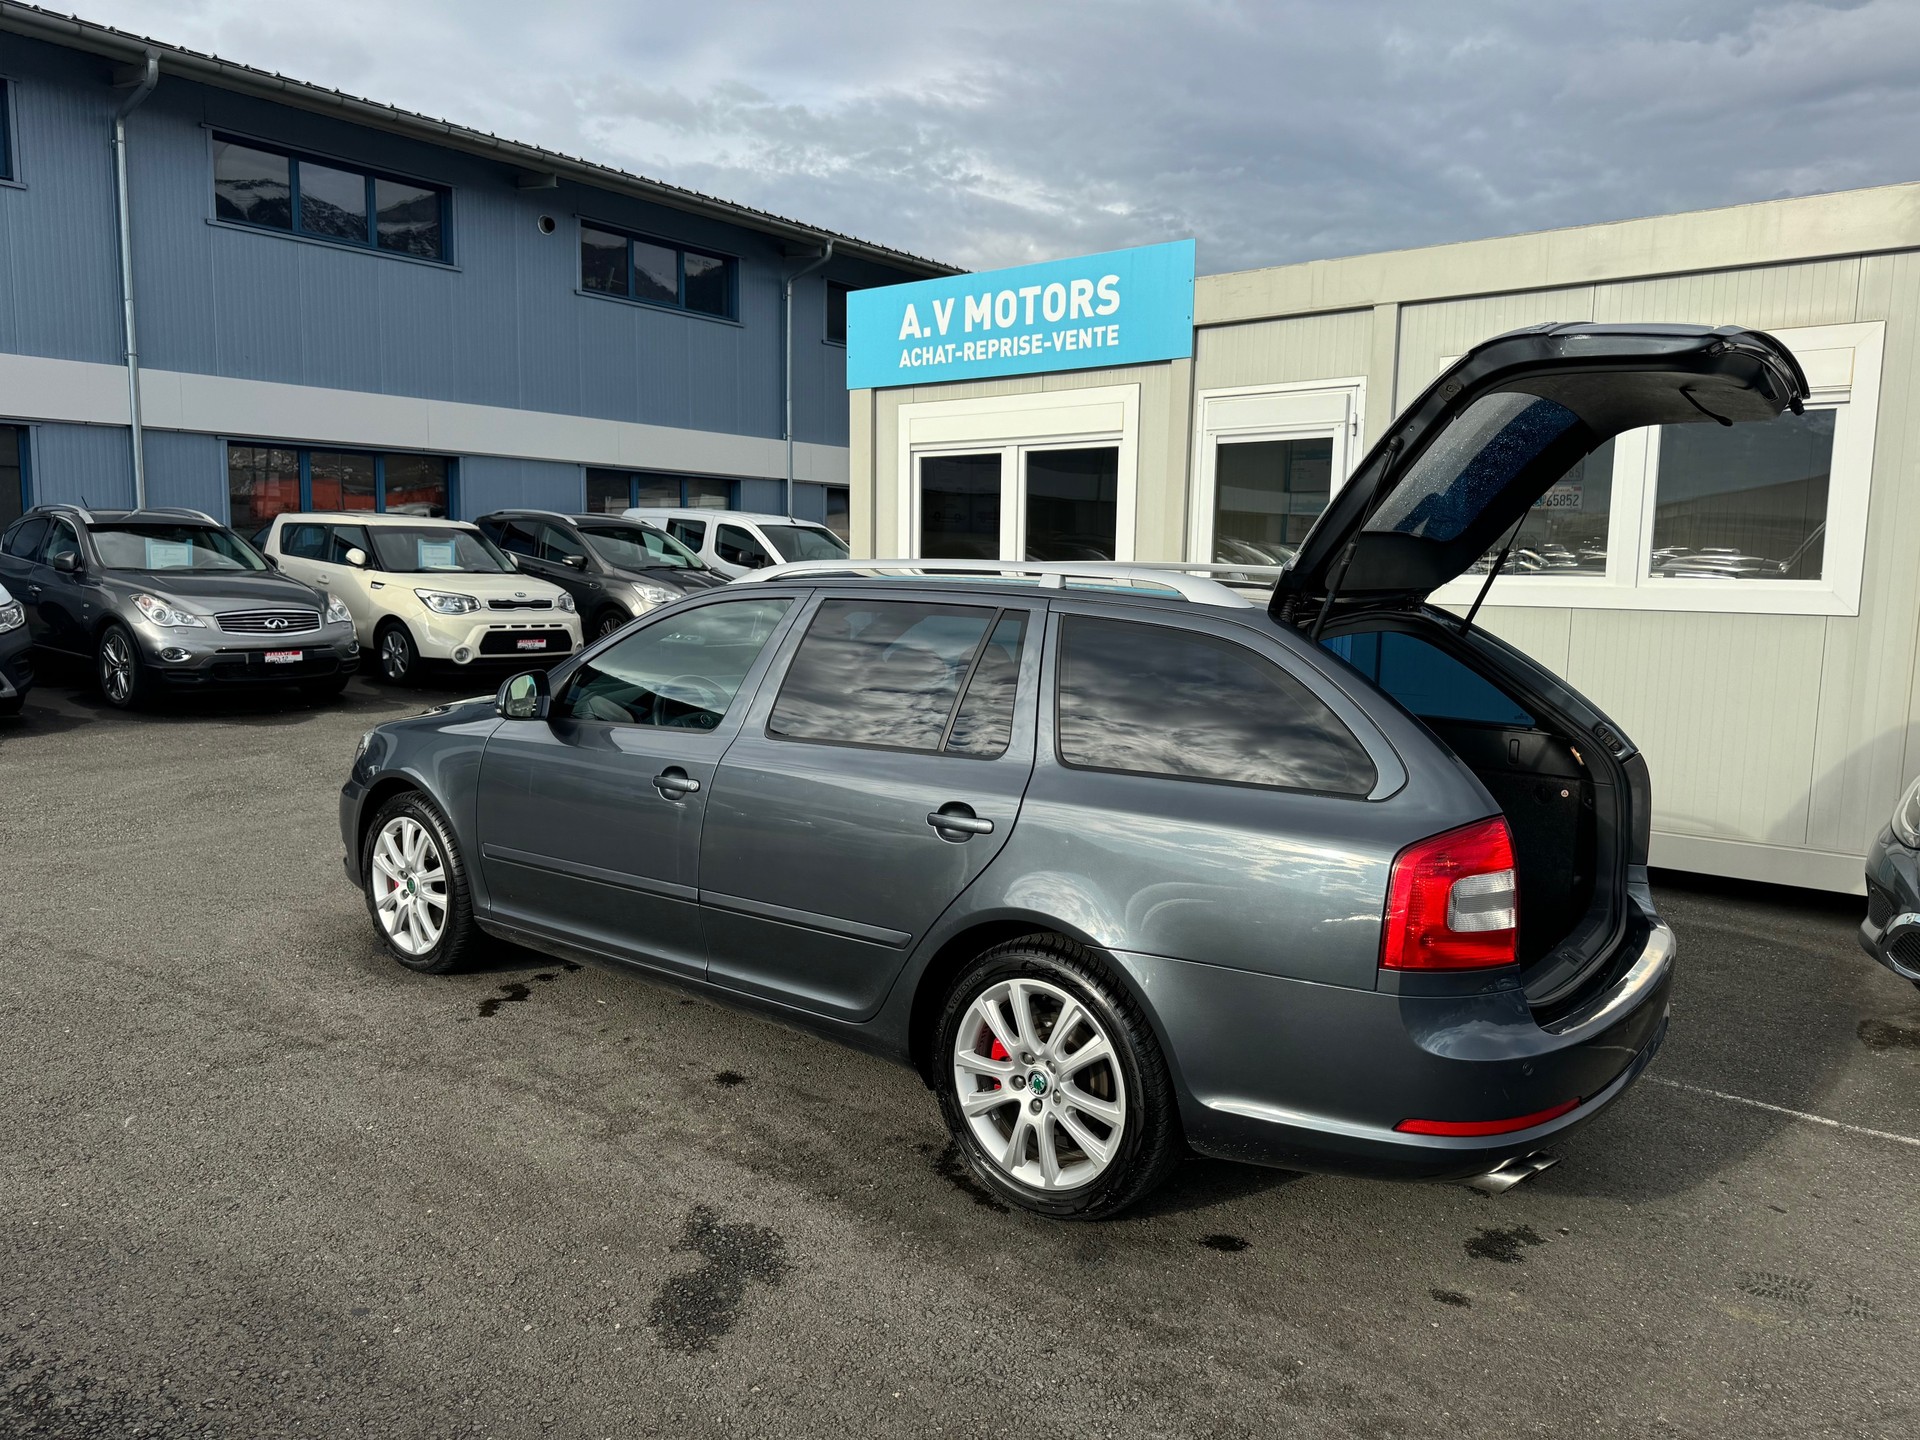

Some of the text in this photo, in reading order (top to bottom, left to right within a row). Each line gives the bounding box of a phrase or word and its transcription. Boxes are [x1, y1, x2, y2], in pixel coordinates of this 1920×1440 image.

[898, 274, 1121, 340] A.V MOTORS
[898, 324, 1120, 368] ACHAT-REPRISE-VENTE
